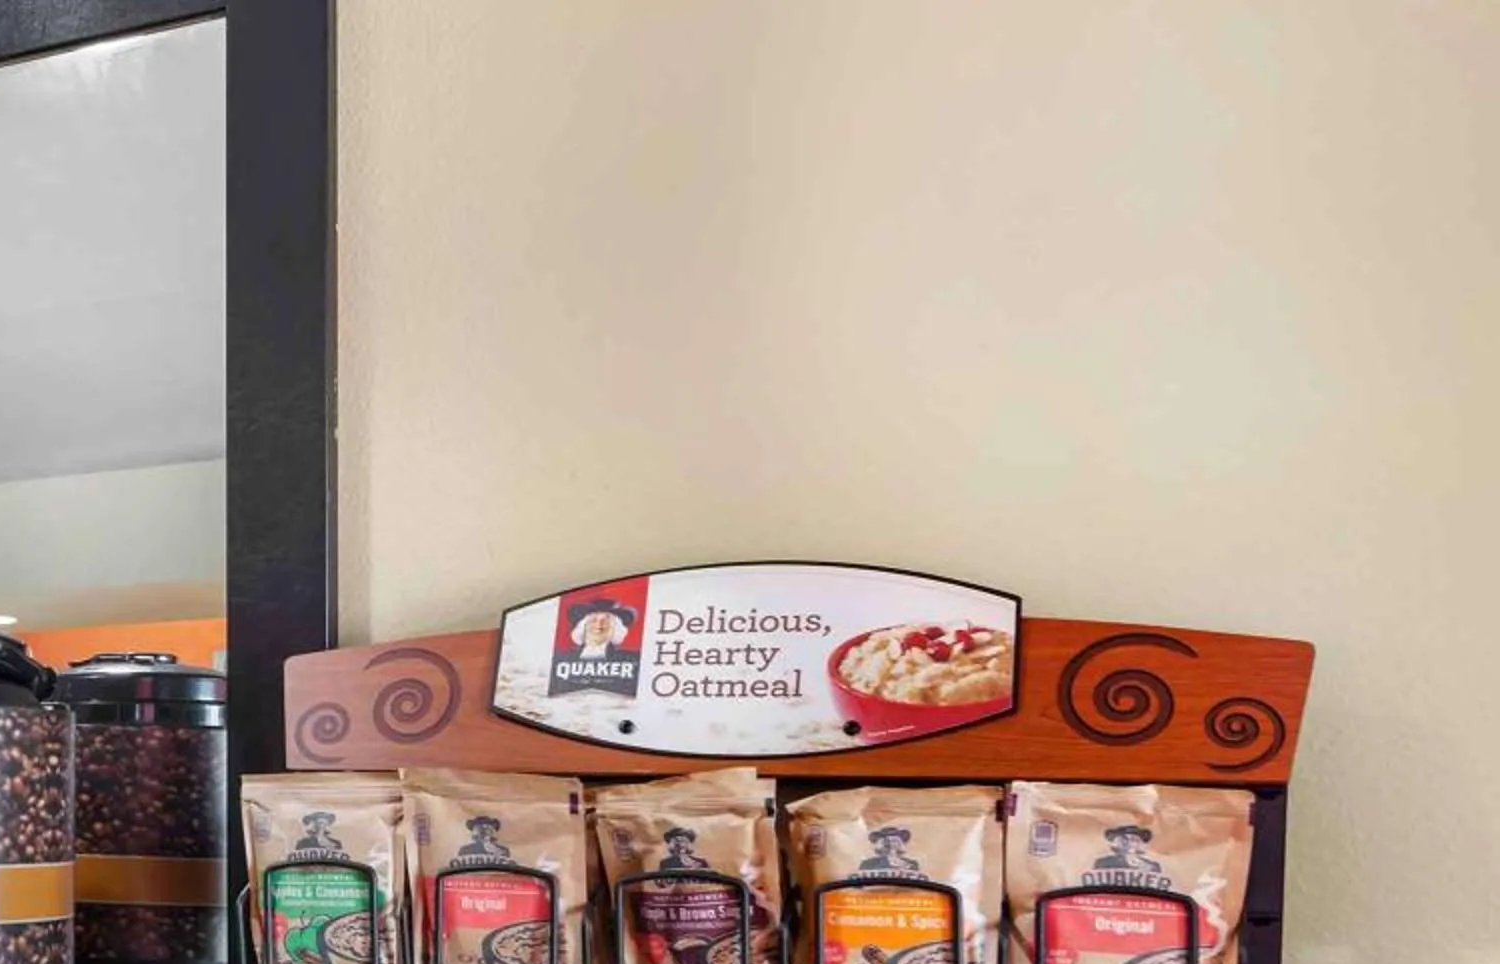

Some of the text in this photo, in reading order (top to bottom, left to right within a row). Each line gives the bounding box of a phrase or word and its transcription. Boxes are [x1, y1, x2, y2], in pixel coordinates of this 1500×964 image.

[657, 606, 832, 638] Delicious,
[556, 661, 636, 679] QUAKER
[652, 641, 780, 672] Hearty
[651, 670, 803, 698] Oatmeal
[1094, 917, 1155, 936] Original
